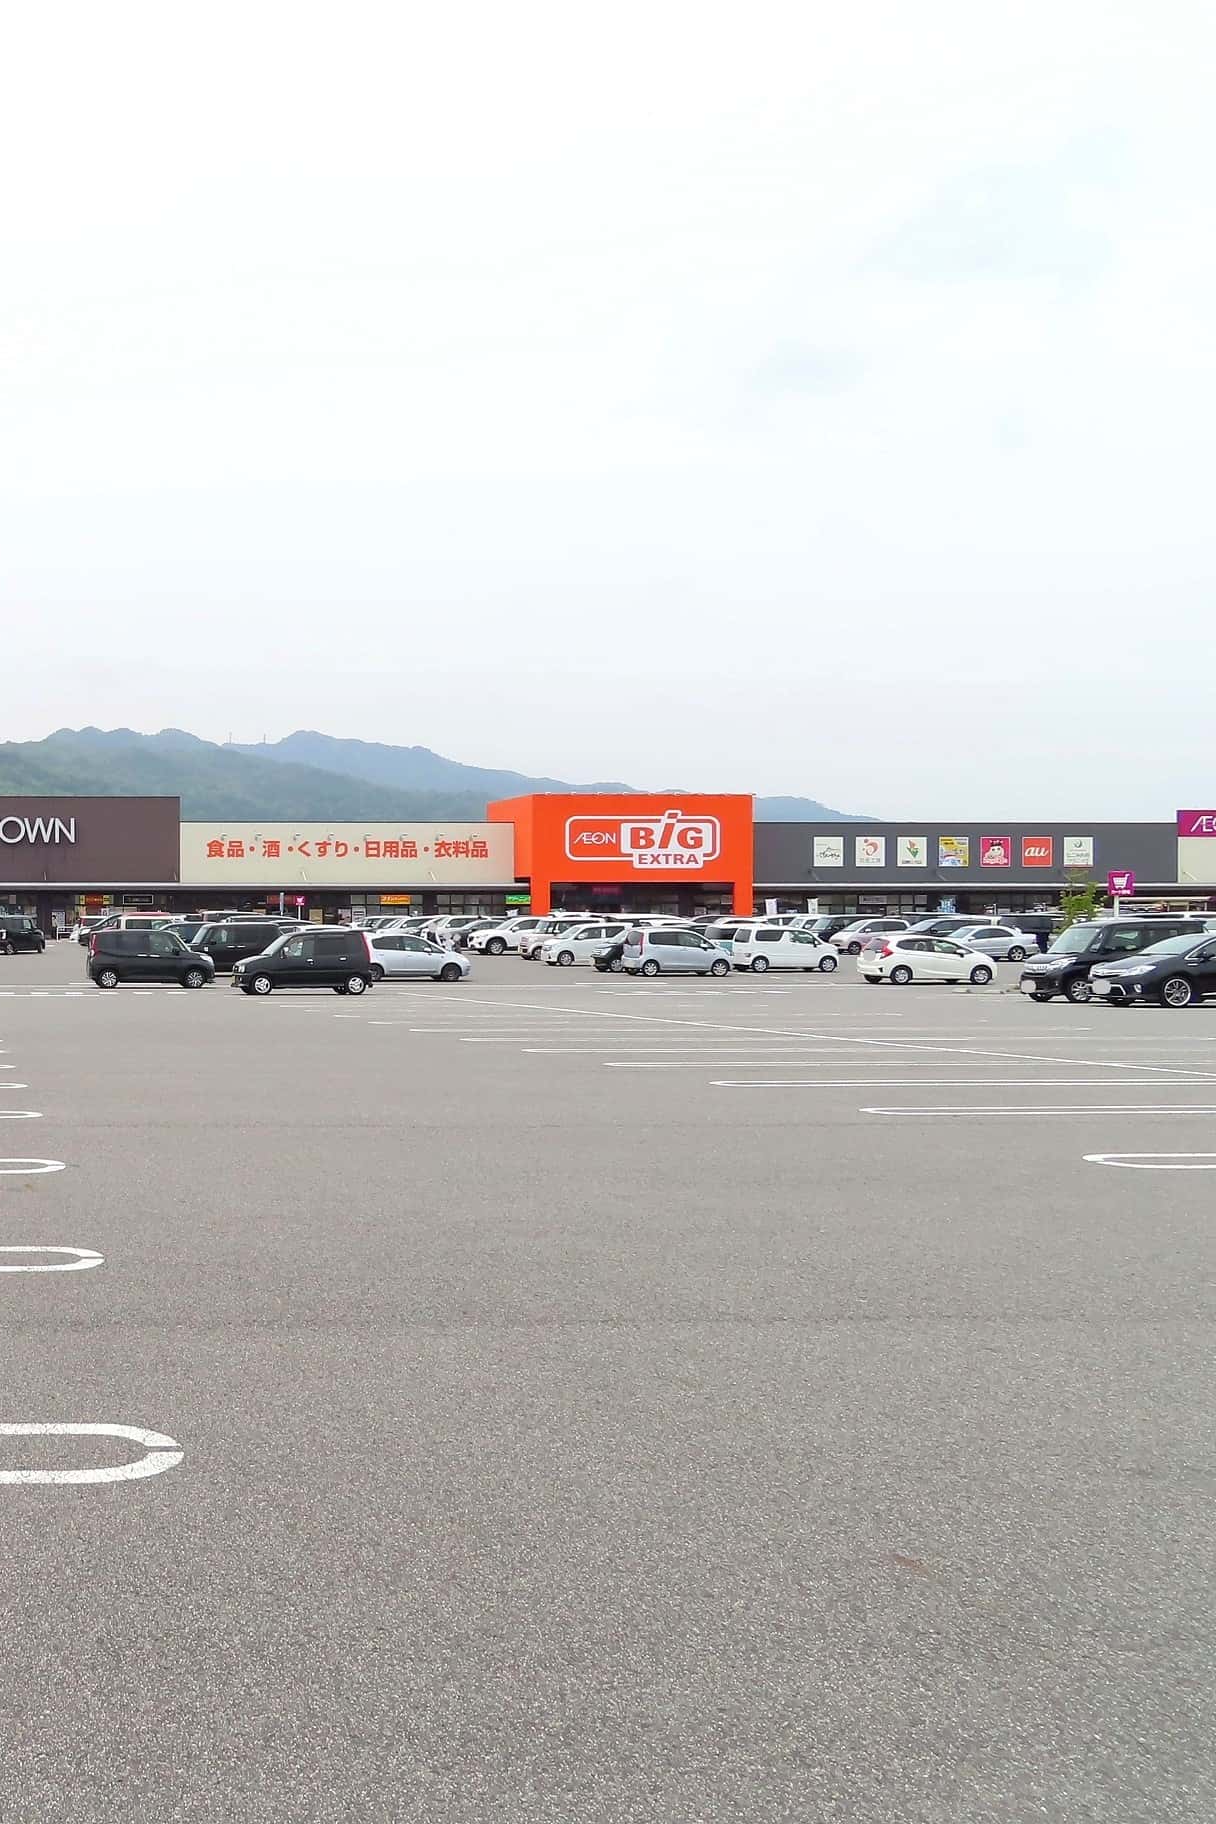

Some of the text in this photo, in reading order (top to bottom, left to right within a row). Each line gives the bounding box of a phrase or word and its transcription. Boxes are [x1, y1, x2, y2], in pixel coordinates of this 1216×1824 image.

[206, 839, 489, 858] 食品・酒・くすり・日用品・衣料品
[1025, 846, 1049, 857] au
[637, 853, 700, 866] EXTRA
